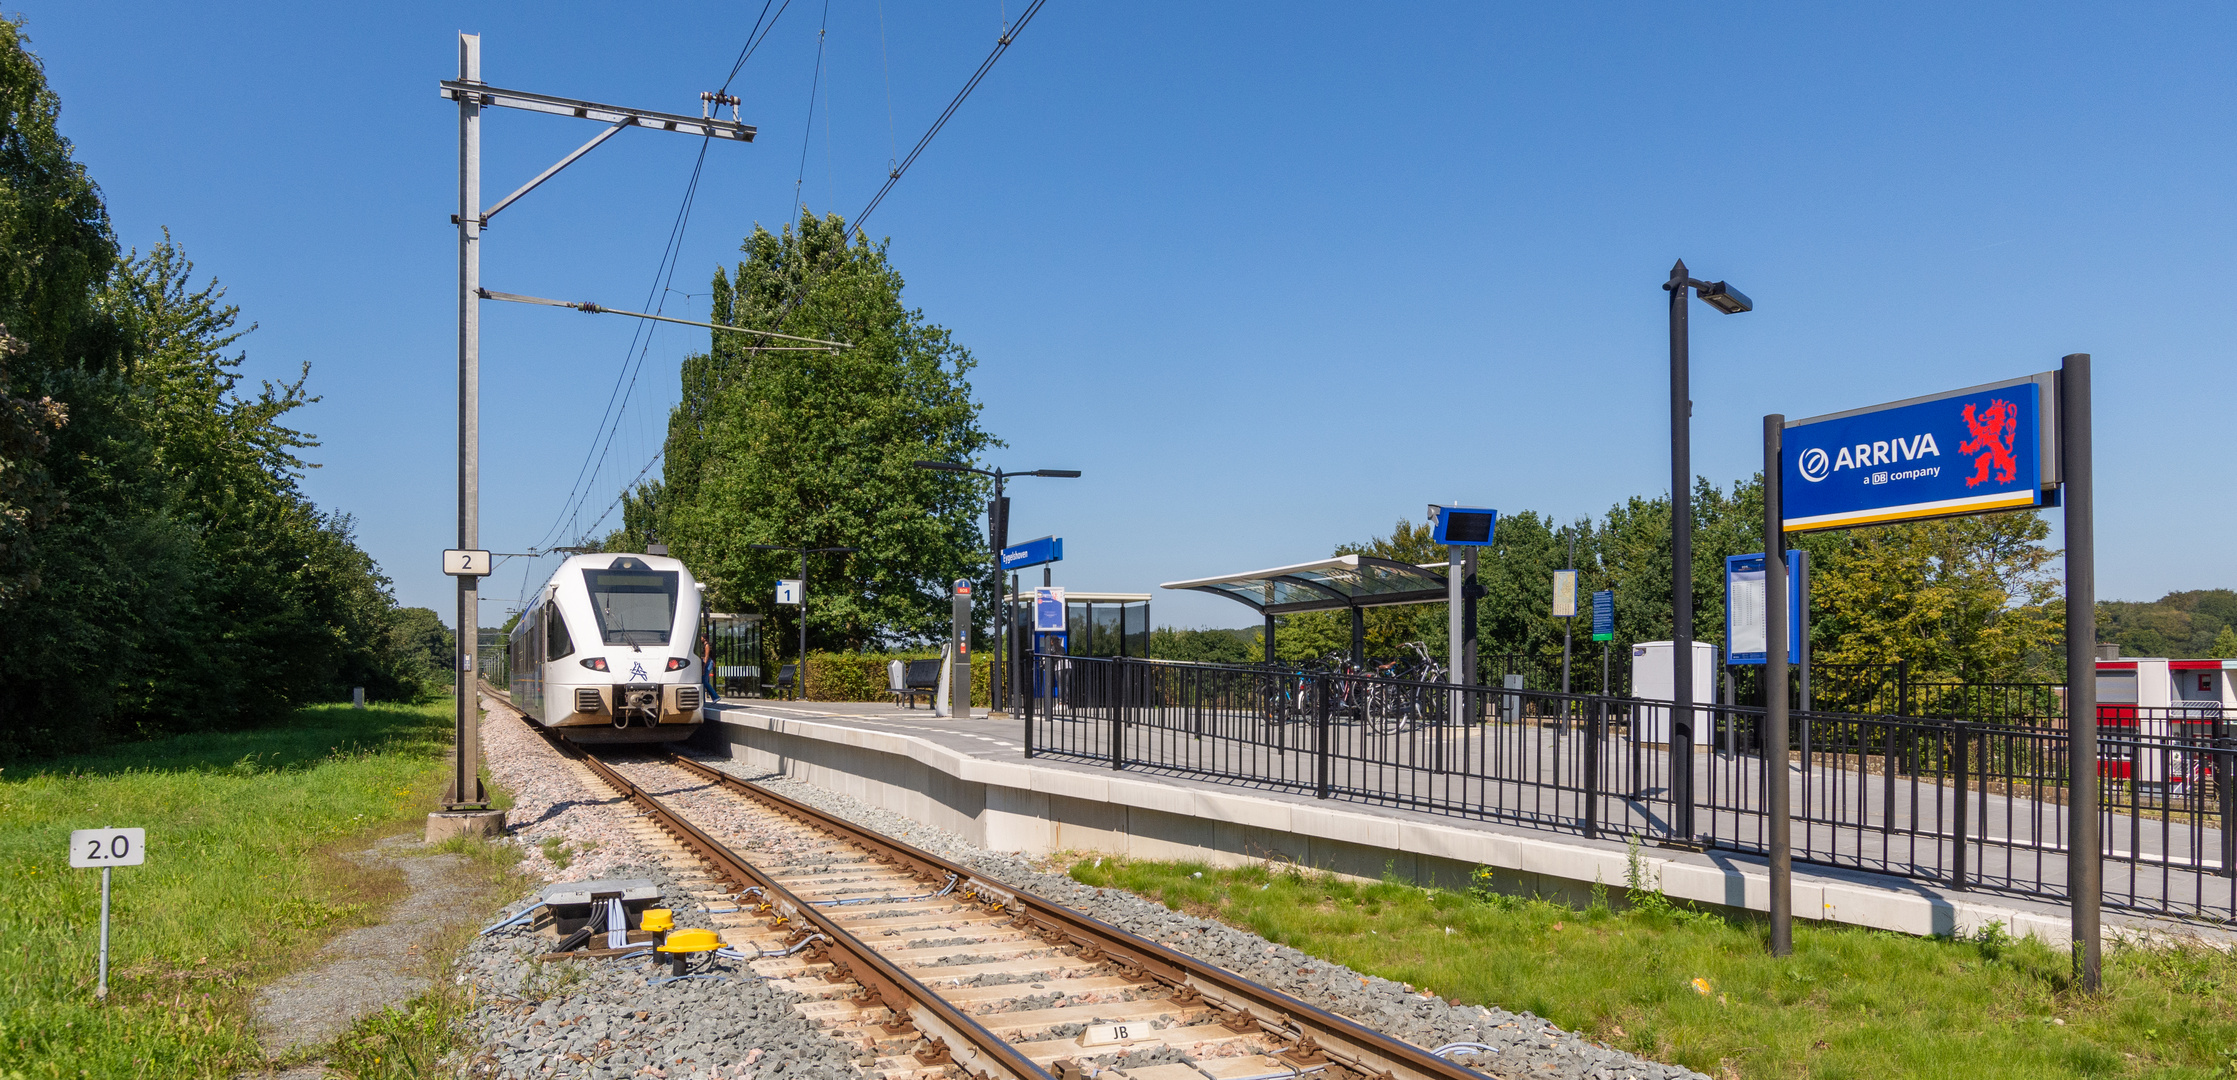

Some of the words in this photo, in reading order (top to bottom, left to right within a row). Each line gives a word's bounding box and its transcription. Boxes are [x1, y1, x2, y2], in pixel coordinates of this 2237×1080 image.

[1833, 433, 1940, 471] ARRIVA
[1863, 475, 1870, 485] a
[1873, 472, 1888, 485] DB
[1890, 466, 1941, 482] company
[462, 555, 472, 569] 2
[1003, 551, 1028, 564] Eygelshoven
[784, 589, 790, 602] 1
[87, 834, 130, 860] 2.0
[1113, 1025, 1129, 1040] JB
